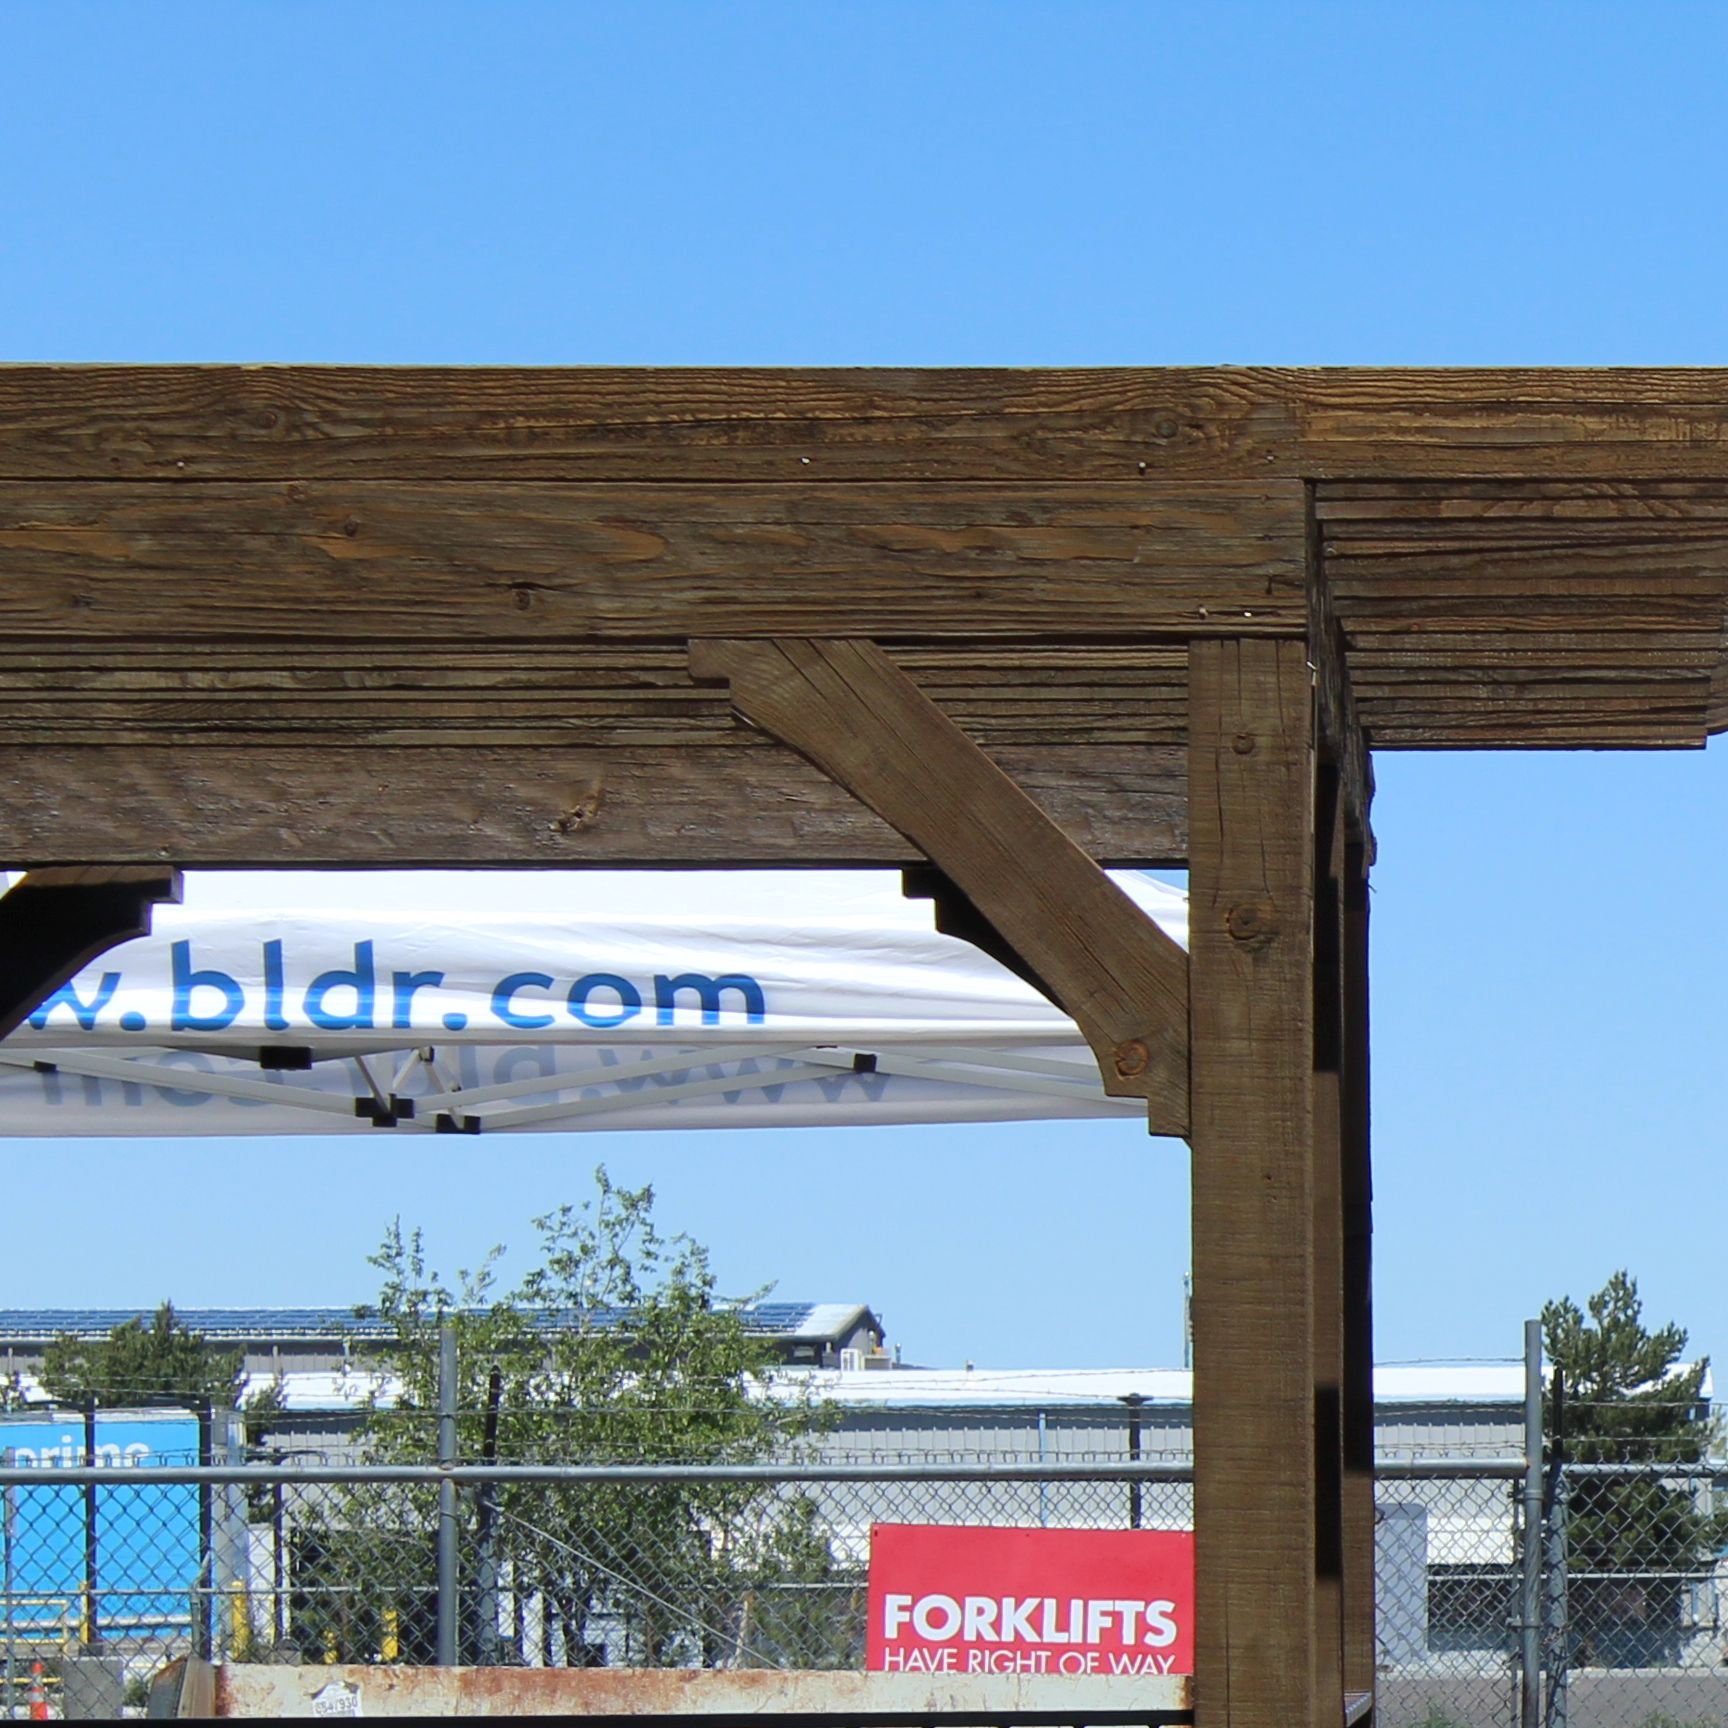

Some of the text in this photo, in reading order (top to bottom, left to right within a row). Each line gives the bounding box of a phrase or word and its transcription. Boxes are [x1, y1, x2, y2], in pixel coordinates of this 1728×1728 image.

[884, 1594, 1177, 1647] FORKLIFTS
[884, 1648, 1176, 1674] HAVE RIGHT OF WAY
